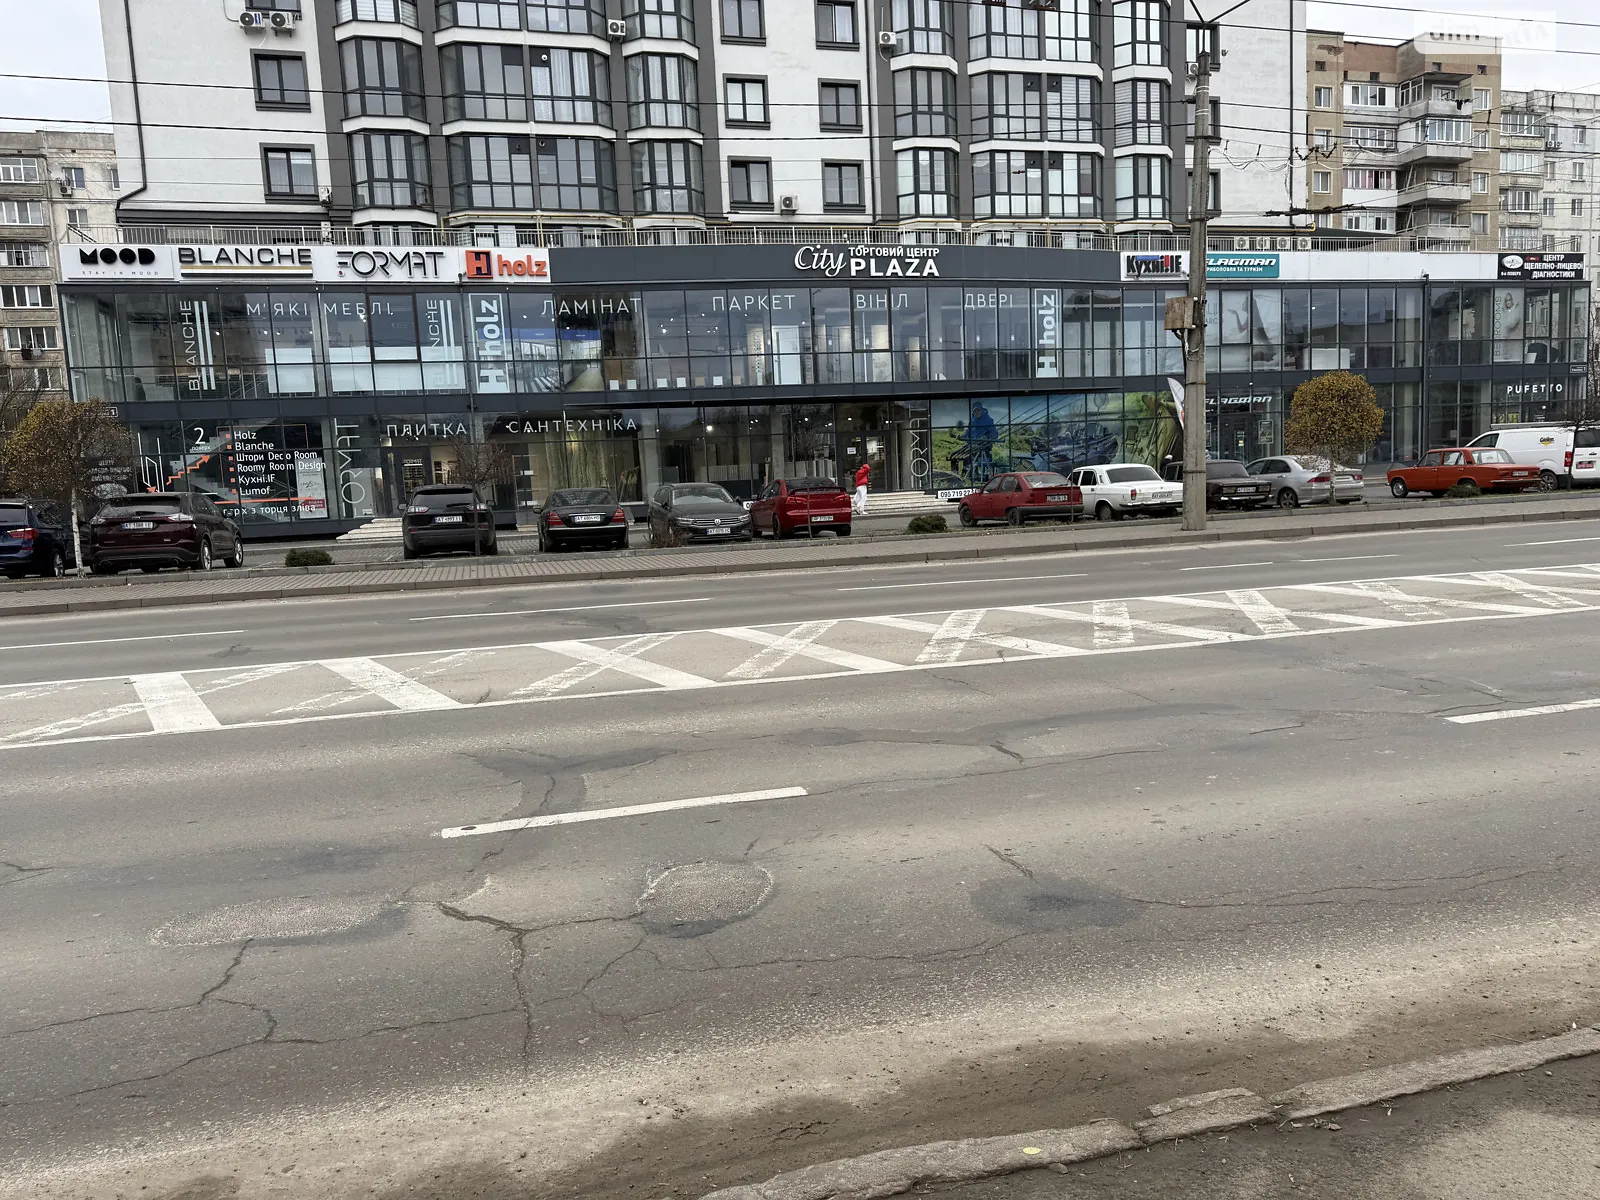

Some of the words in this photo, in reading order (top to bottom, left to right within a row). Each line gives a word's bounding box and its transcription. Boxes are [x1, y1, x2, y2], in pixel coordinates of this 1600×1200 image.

[79, 248, 155, 265] MOOD
[178, 247, 312, 264] BLANCHE
[794, 244, 846, 277] City
[848, 246, 904, 257] ТОРГОВИЙ
[907, 247, 940, 258] ЦЕНТР
[1543, 254, 1565, 262] ЦЕНТР
[336, 250, 445, 278] FORMAT
[497, 254, 548, 276] holz
[850, 258, 940, 277] PLAZA
[246, 302, 308, 316] М'ЯКІ
[541, 297, 642, 316] ЛАМІНАТ
[712, 294, 796, 311] ПАРКЕТ
[856, 294, 909, 309] ВІНІЛ
[964, 293, 1013, 310] ДВЕРІ
[476, 299, 502, 356] holz
[1038, 294, 1055, 345] holz
[1494, 295, 1502, 357] BEROOMS
[180, 300, 201, 391] BLANCHE
[1507, 383, 1563, 394] PUFETTO
[387, 422, 467, 437] ПЛИТКА
[508, 418, 637, 434] САНТЕХНІКА
[193, 427, 205, 445] 2
[234, 431, 257, 440] Holz
[235, 442, 274, 451] Blanche
[236, 453, 264, 464] Штори
[294, 450, 318, 460] Room
[237, 463, 266, 473] Roomy
[298, 460, 327, 472] Design
[940, 490, 951, 498] 095
[260, 506, 288, 514] торця
